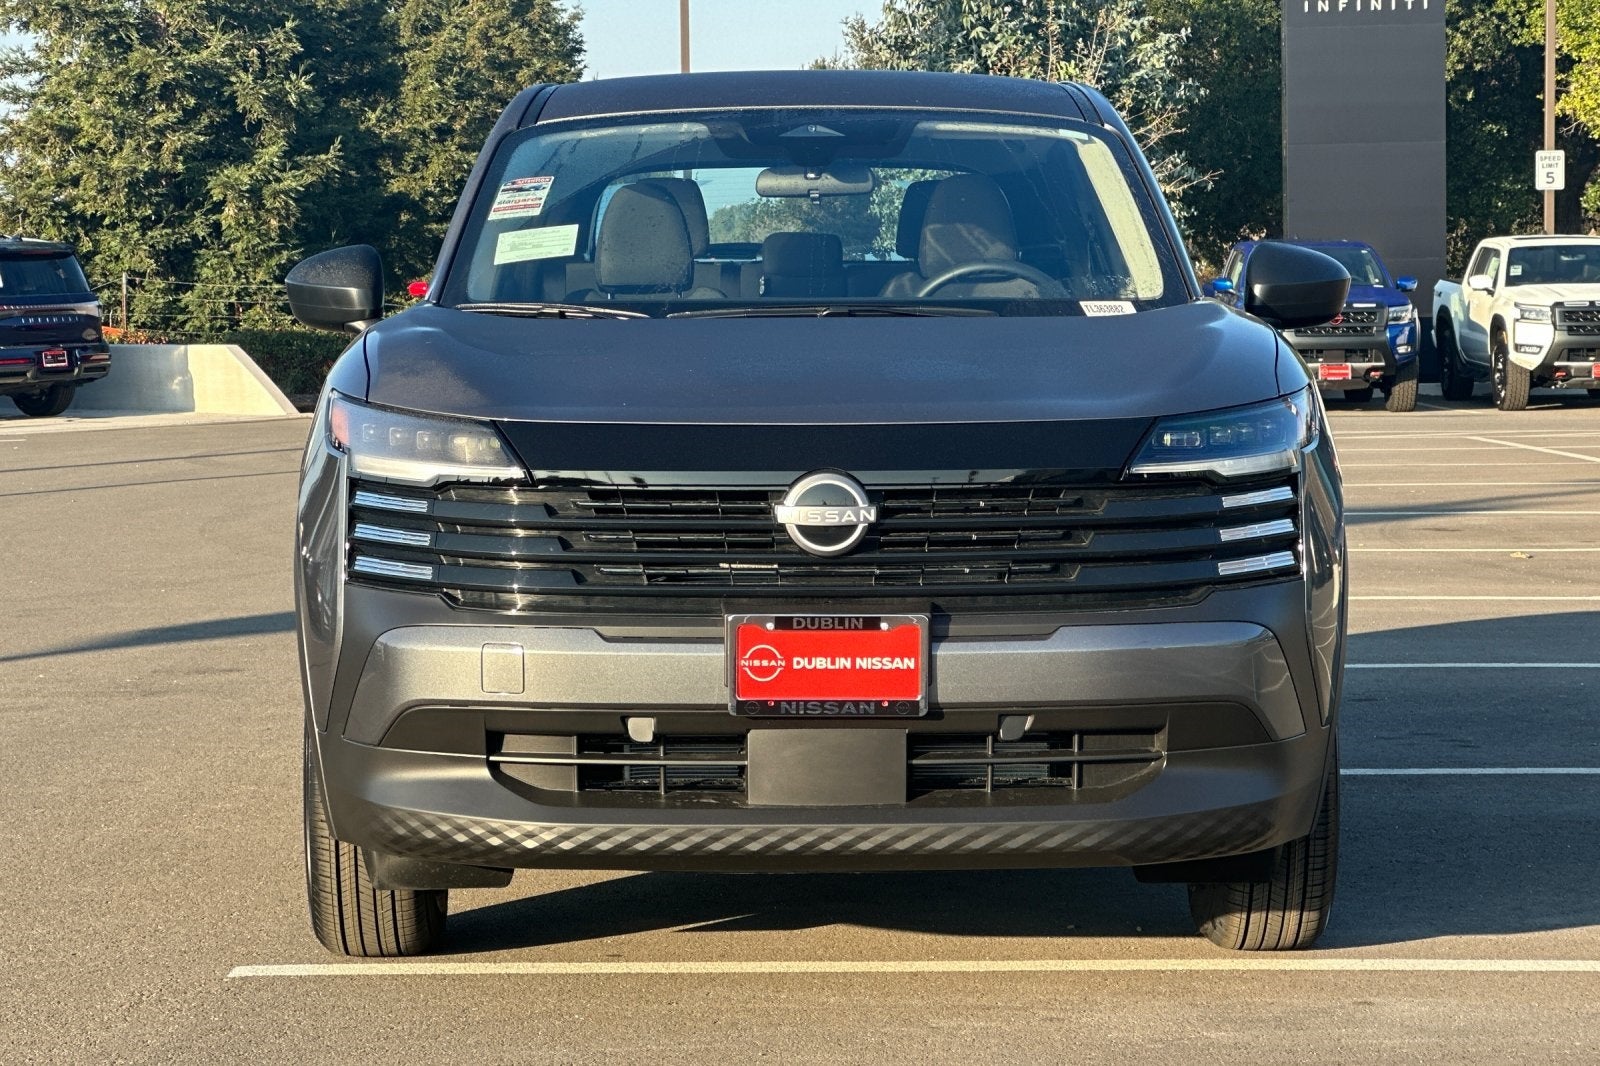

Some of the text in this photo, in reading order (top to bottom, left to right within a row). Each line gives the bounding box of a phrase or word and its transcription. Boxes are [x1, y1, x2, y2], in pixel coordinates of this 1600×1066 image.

[1303, 0, 1429, 13] INFINITI
[1545, 171, 1555, 185] 5
[782, 509, 875, 522] NISSAN
[793, 617, 863, 629] DUBLIN
[740, 658, 786, 667] NISSAN
[793, 657, 915, 669] DUBLIN NISSAN
[781, 701, 875, 715] NISSAN
